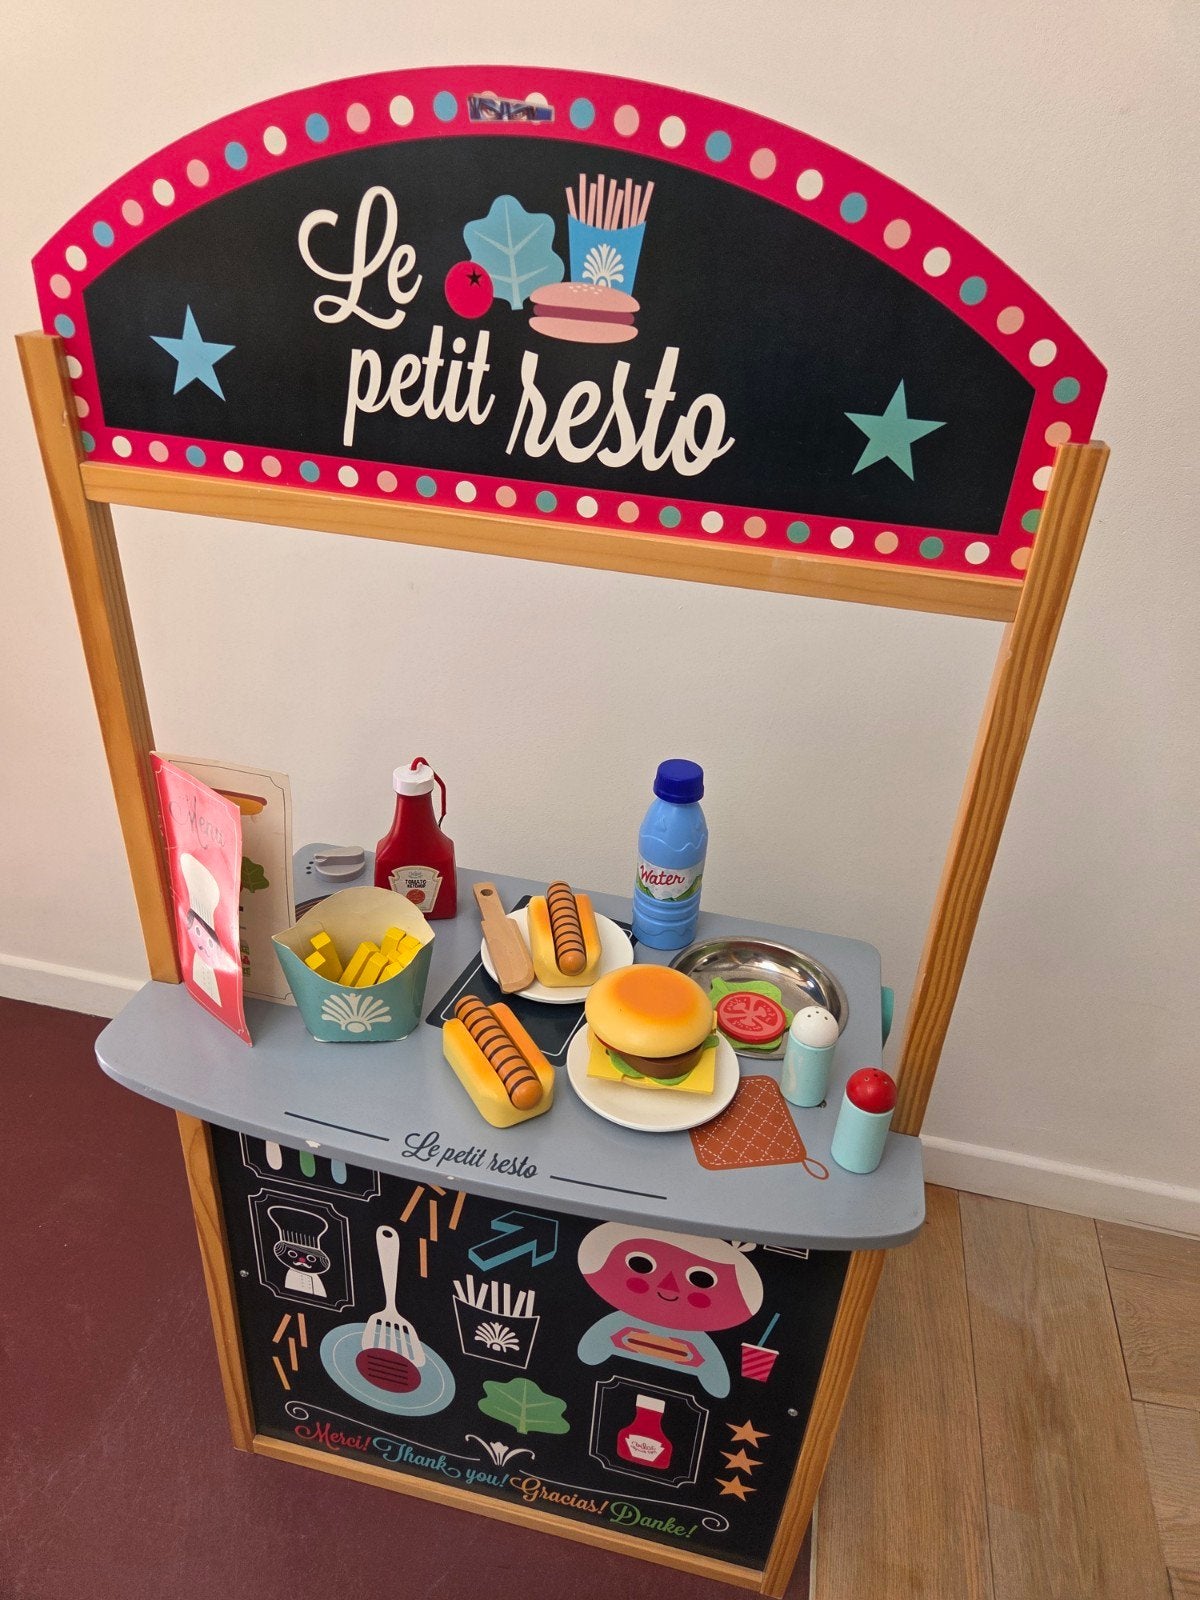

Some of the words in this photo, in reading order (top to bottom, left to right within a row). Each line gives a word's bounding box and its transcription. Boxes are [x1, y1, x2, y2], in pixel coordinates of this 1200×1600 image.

[297, 185, 423, 330] Le
[342, 324, 496, 447] petit
[505, 345, 736, 477] resto
[640, 864, 686, 886] Water
[401, 1131, 440, 1162] Le
[435, 1146, 488, 1168] petit
[485, 1152, 538, 1179] resto
[294, 1422, 372, 1452] Merci!
[372, 1436, 462, 1479] Thank
[466, 1468, 509, 1488] you!
[509, 1476, 609, 1515] Gracias!
[609, 1501, 698, 1538] Danke!
